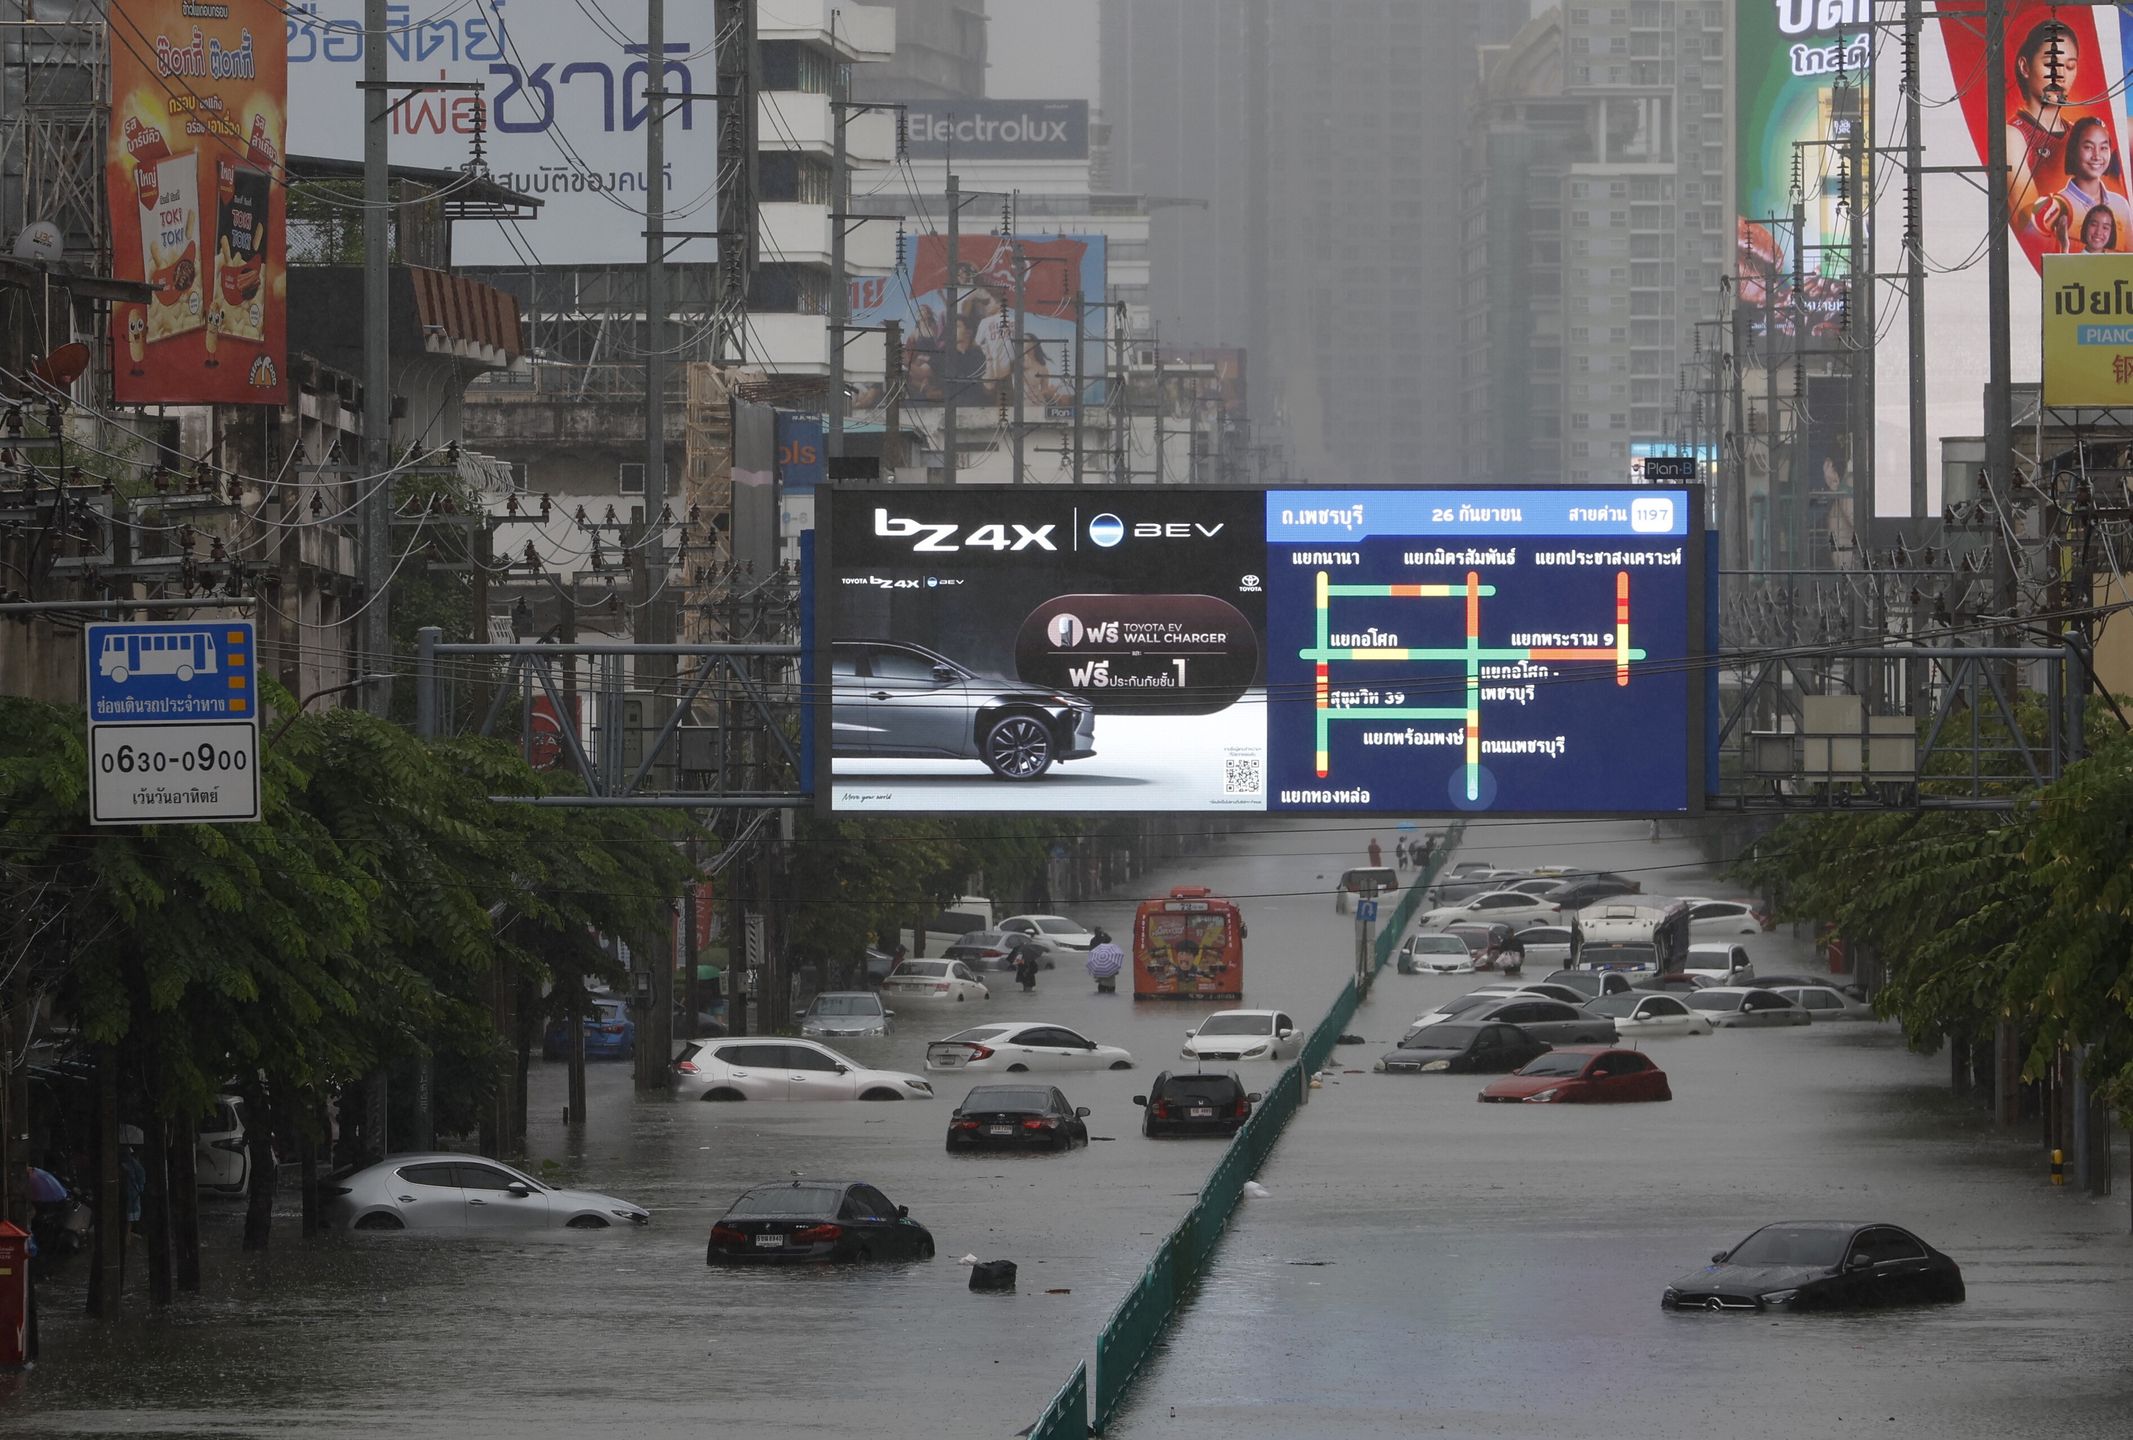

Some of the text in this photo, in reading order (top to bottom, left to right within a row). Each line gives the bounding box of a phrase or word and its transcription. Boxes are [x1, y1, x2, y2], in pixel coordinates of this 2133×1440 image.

[908, 113, 1067, 142] Electrolux
[1282, 504, 1364, 532] ถ.เพชรบุรี
[1432, 503, 1522, 522] 26 กันยายน
[1568, 505, 1668, 522] สายด่วน 1197
[1134, 522, 1224, 538] BEV
[1292, 551, 1360, 565] แยกนานา
[1404, 547, 1516, 565] แยกมิตรสัมพันธ์
[1535, 547, 1682, 566] แยกประชาสงเคราะห์
[1087, 620, 1119, 643] ฟรี
[1124, 623, 1183, 632] TOYOTA EV
[1124, 633, 1161, 643] WALL
[1330, 628, 1398, 647] แยกอโศก
[1511, 632, 1614, 646] แยกพระราม 9
[97, 694, 225, 714] ช่องเดินรถประจำทาง
[1384, 692, 1405, 704] 39
[1481, 684, 1535, 705] เพชรบุรี
[1363, 728, 1464, 746] แยกพร้อมพงษ์
[1481, 736, 1565, 758] ถนนเพชรบุรี
[101, 743, 247, 773] 0630-0900
[132, 786, 219, 806] เว้นวันอาทิตย์
[1281, 786, 1370, 803] แยกทองหล่อ
